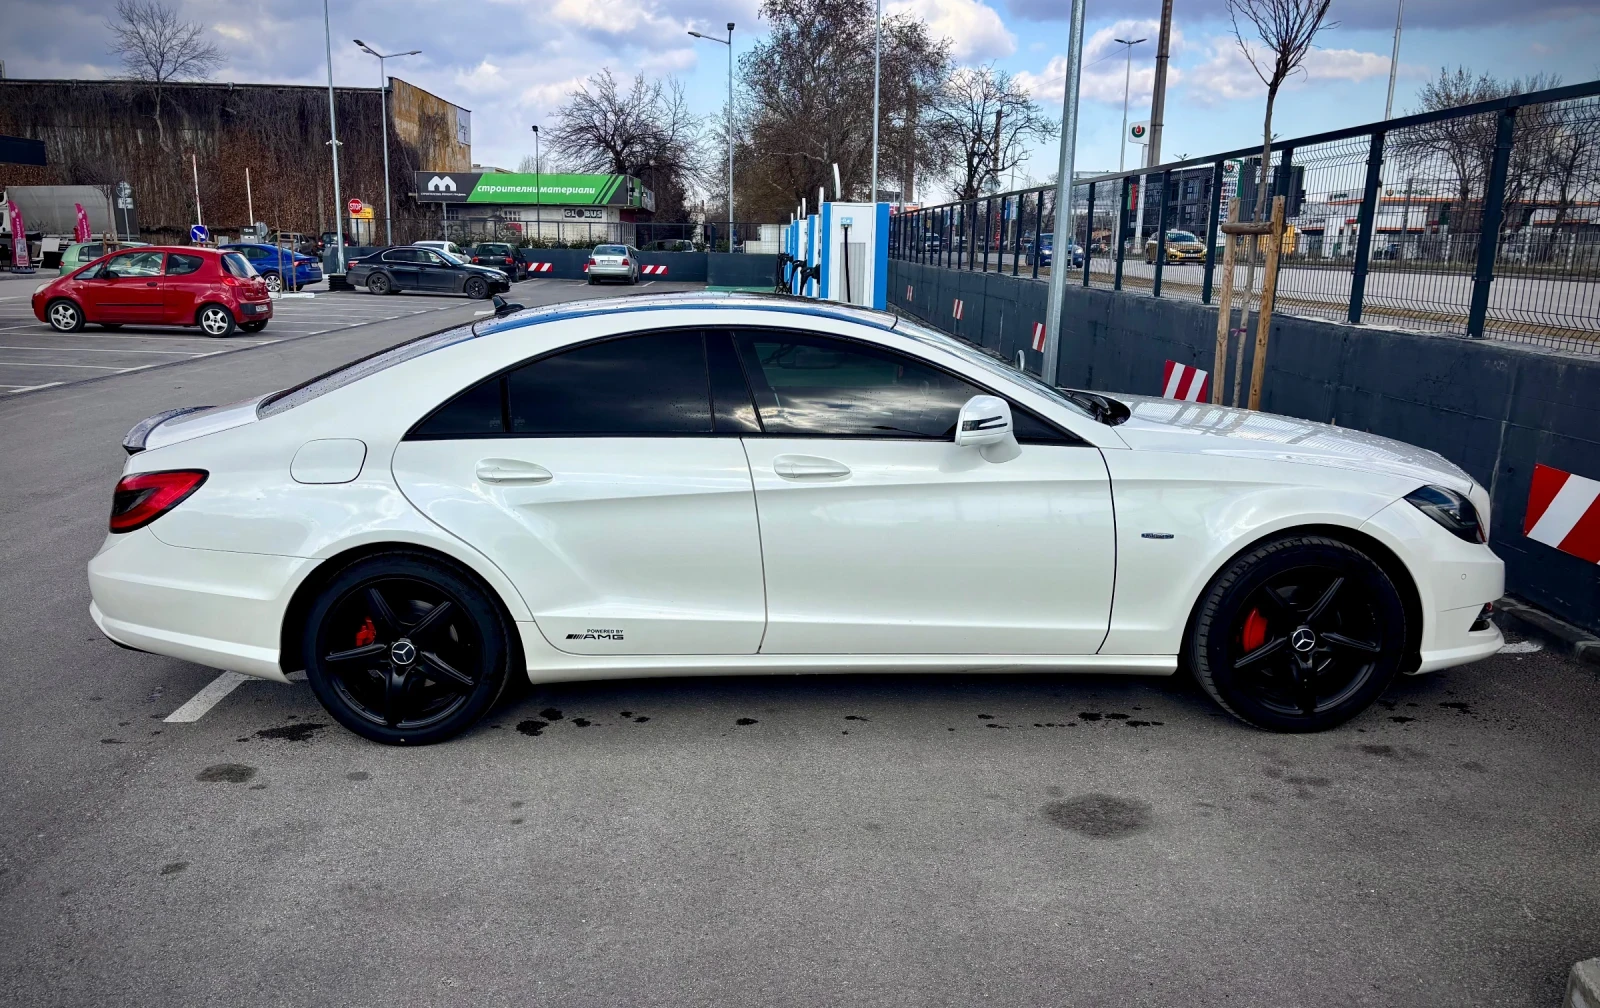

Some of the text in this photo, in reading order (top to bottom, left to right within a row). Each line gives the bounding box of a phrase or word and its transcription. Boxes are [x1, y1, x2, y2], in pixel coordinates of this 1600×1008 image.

[477, 185, 596, 195] строителни материали
[564, 209, 603, 218] GLOBUS
